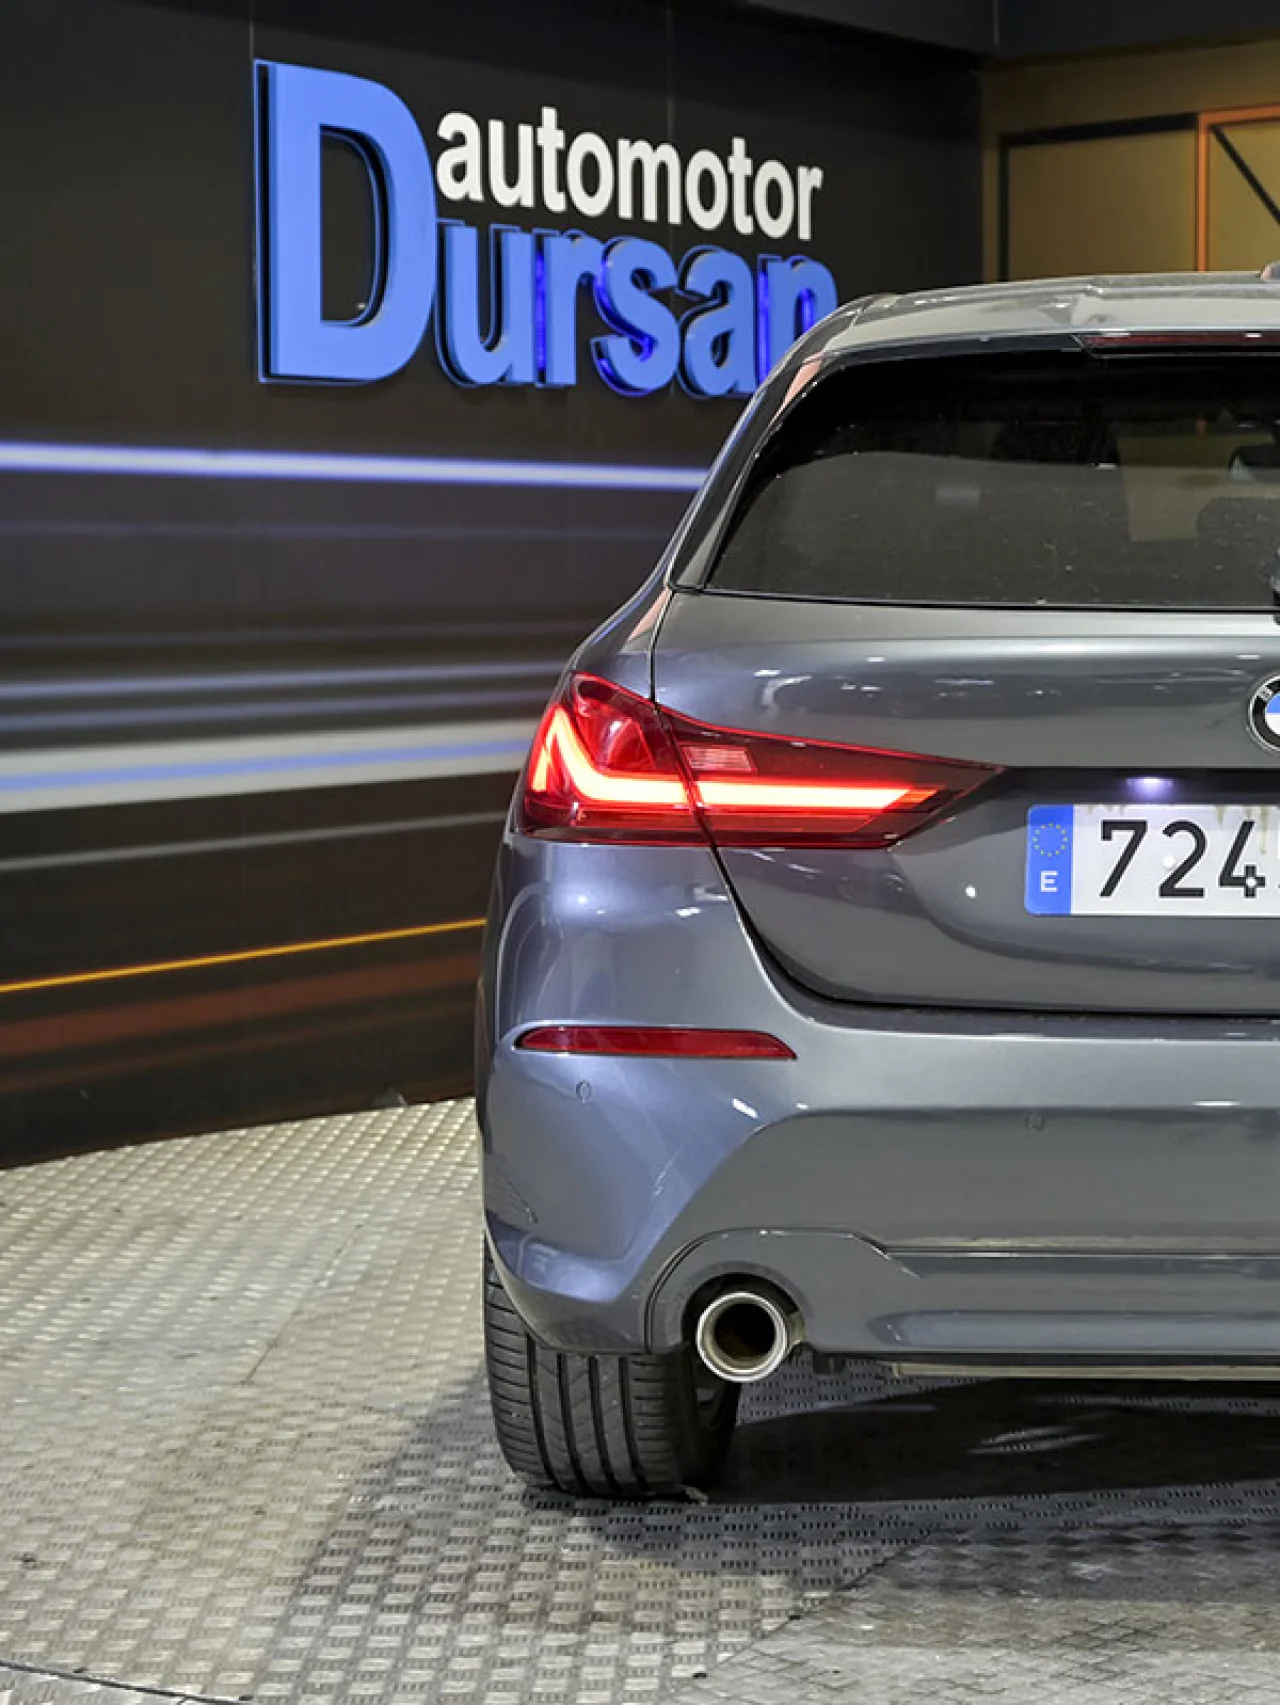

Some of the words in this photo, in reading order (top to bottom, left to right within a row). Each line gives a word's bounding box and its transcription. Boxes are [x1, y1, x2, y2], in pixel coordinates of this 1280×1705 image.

[253, 57, 840, 400] Dursan
[435, 106, 824, 241] automotor
[1040, 870, 1059, 893] E
